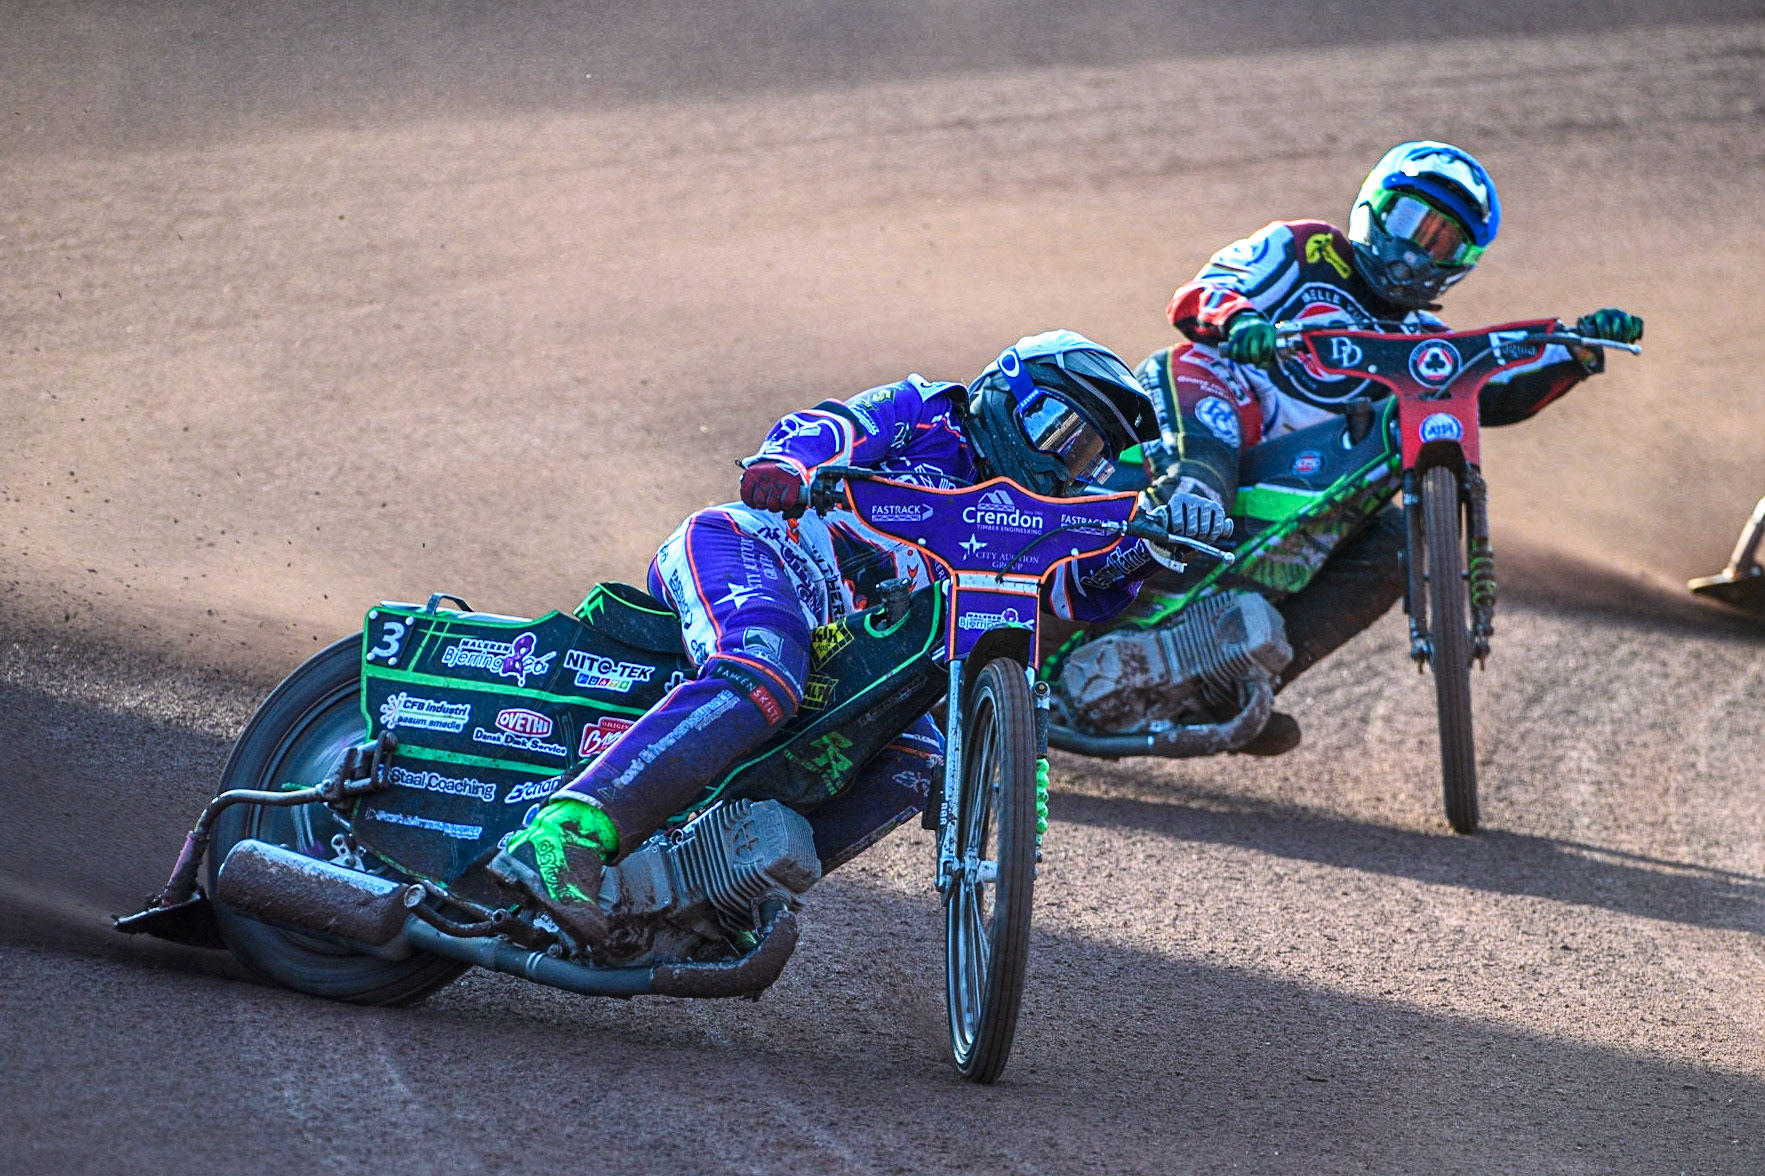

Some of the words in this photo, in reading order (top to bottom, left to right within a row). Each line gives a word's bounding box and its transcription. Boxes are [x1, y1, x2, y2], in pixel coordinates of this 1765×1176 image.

[872, 505, 921, 515] FASTRACK
[962, 507, 1044, 529] Crendon
[1061, 514, 1105, 526] FASTRAC
[977, 524, 1000, 532] TIMBER
[1001, 526, 1042, 536] ENGINEERING
[976, 551, 998, 560] CITY
[1000, 553, 1041, 564] AUCION
[992, 561, 1023, 571] GRUP
[371, 621, 405, 658] 3
[442, 645, 504, 673] Bjerring
[403, 700, 425, 711] CFB
[474, 728, 502, 742] Dansk
[529, 739, 566, 755] Service
[390, 768, 427, 787] Staal
[427, 775, 495, 800] Coaching
